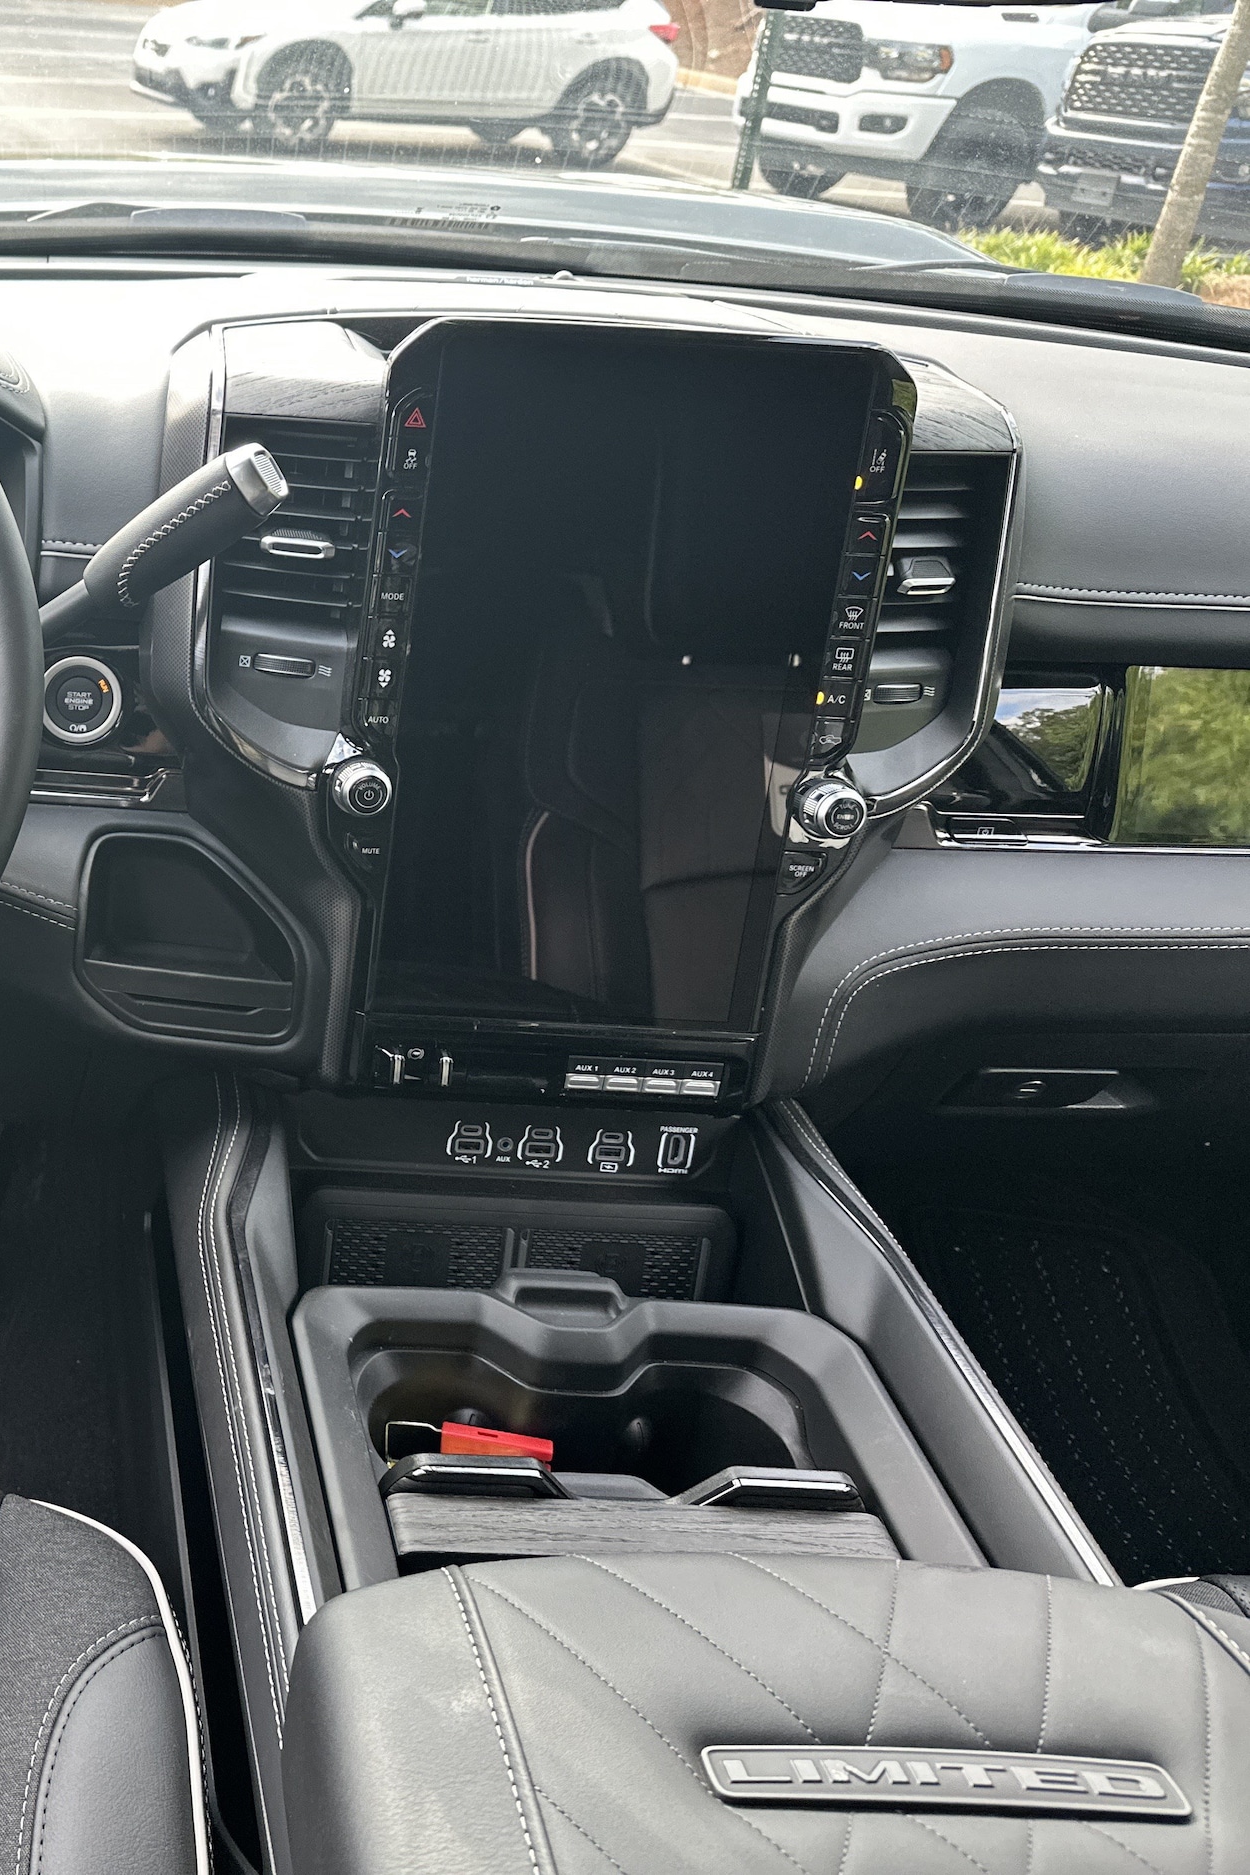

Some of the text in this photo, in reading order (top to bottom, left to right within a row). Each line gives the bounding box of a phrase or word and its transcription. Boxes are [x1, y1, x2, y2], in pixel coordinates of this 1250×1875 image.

[403, 462, 417, 470] OFF
[381, 592, 404, 601] MODE
[839, 622, 865, 630] FRONT
[832, 663, 853, 671] REAR
[64, 697, 93, 705] ENGINE
[827, 694, 846, 704] A/C
[367, 716, 389, 724] AUTO
[358, 781, 381, 791] VOLUME
[833, 822, 854, 830] SCROLL
[789, 864, 815, 872] SCREEN
[794, 870, 808, 878] OFF
[575, 1064, 593, 1072] AUX
[613, 1066, 630, 1074] AUX
[660, 1125, 699, 1133] PASSENGER
[472, 1156, 477, 1164] 1
[542, 1160, 550, 1169] 2
[722, 1758, 1167, 1798] LIMITED
